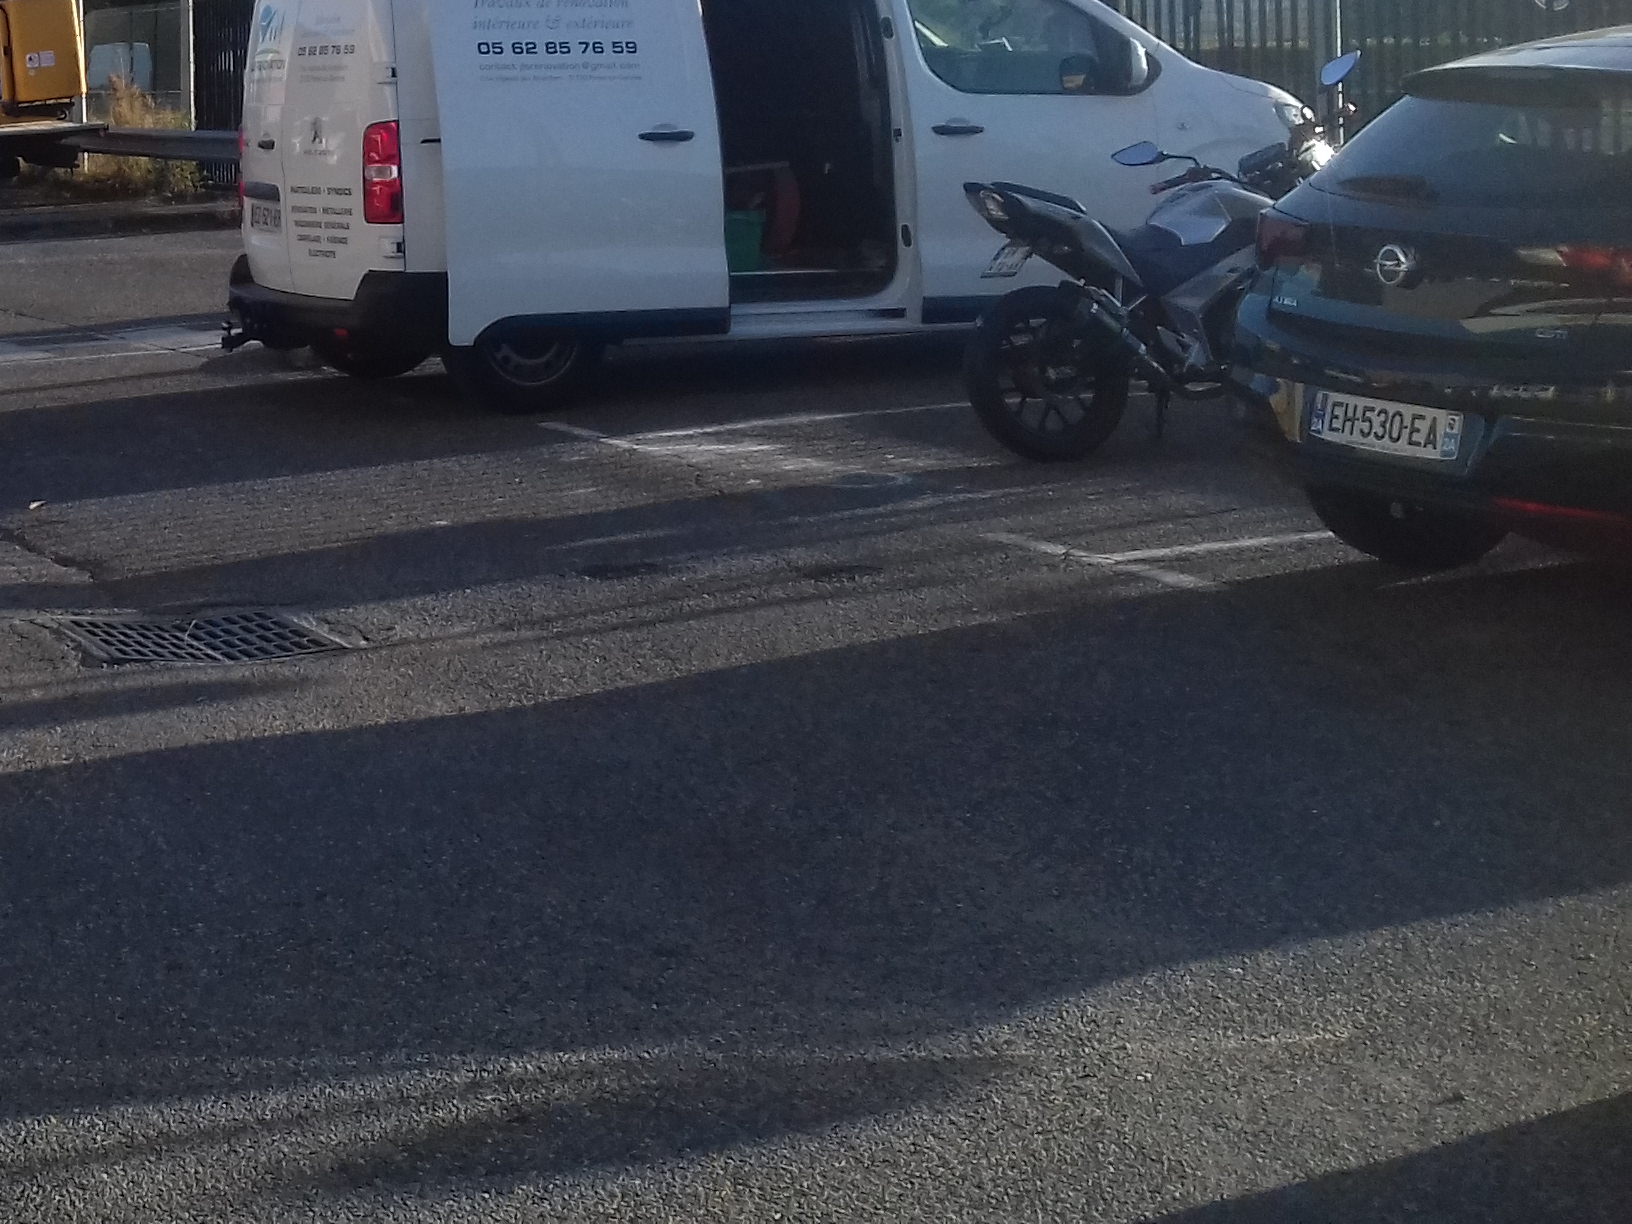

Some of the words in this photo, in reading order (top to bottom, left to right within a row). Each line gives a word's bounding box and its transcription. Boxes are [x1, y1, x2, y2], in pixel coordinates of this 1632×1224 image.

[330, 44, 341, 55] 76
[343, 44, 355, 55] 59
[477, 41, 504, 55] 05
[511, 41, 538, 55] 62
[544, 41, 571, 55] 85
[577, 41, 605, 55] 76
[611, 41, 638, 55] 59
[1328, 400, 1438, 450] EH-530-EA
